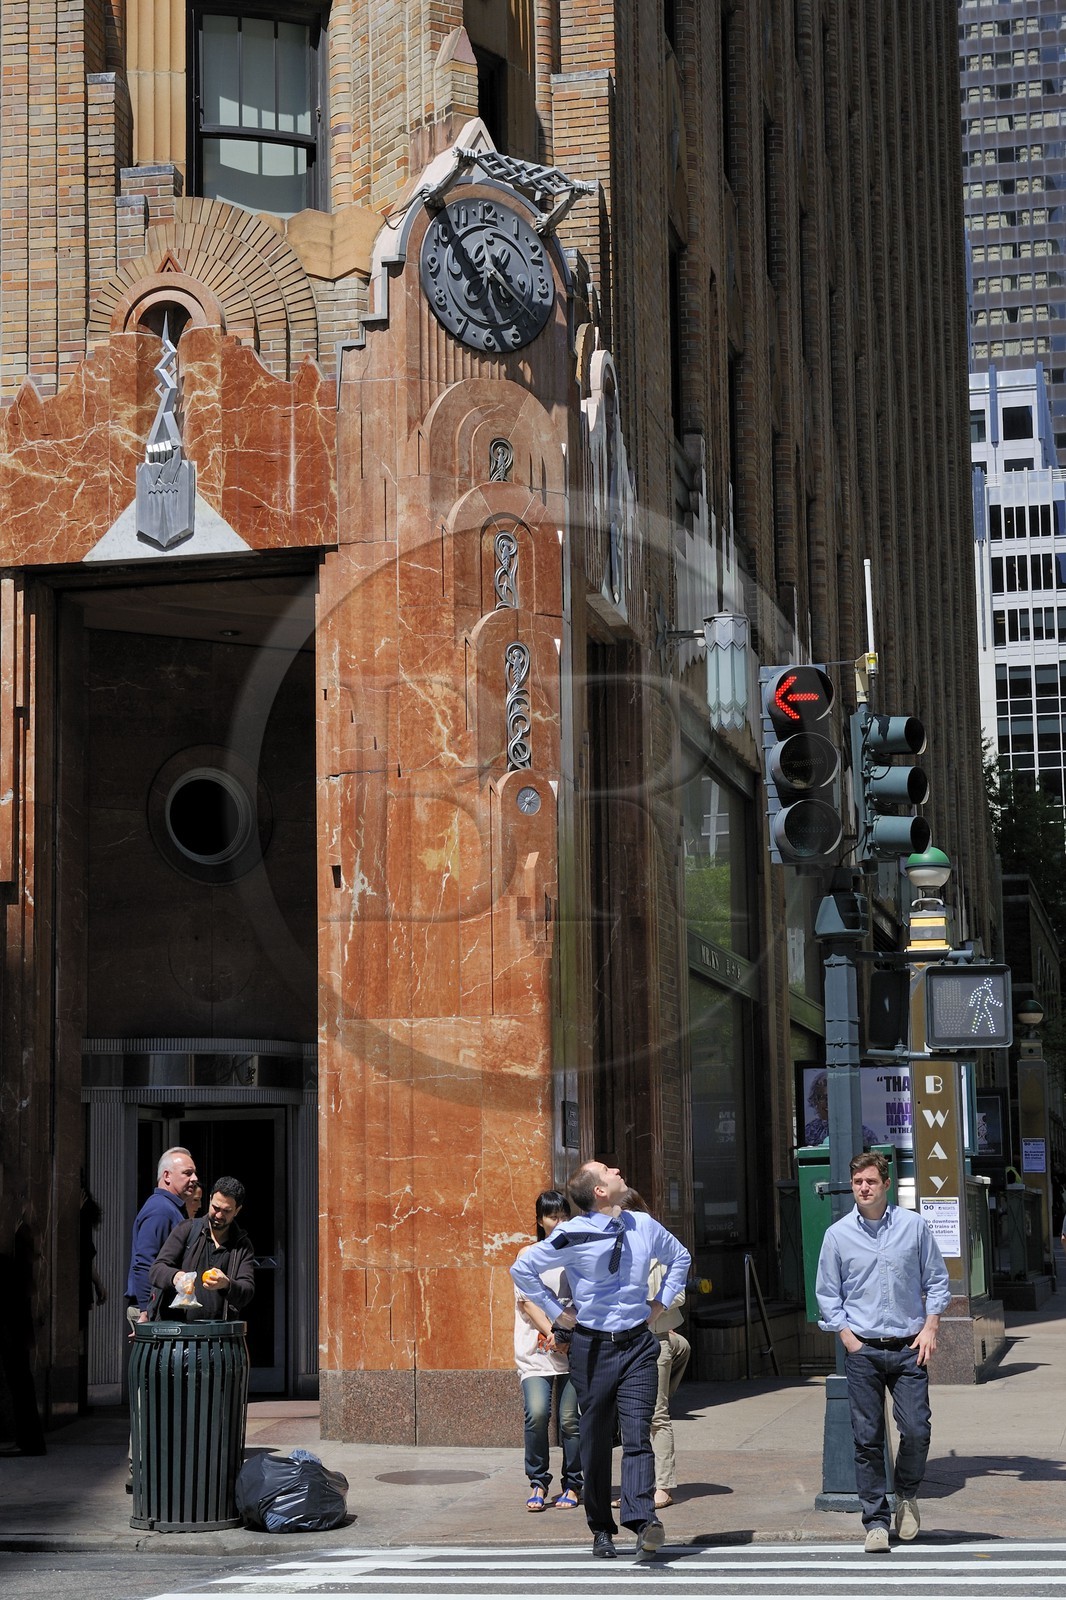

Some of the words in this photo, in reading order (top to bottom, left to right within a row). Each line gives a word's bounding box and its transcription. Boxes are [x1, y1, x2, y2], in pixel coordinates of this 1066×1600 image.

[453, 204, 468, 227] 11
[478, 201, 498, 223] 12
[512, 217, 519, 239] 1
[427, 254, 440, 274] 9
[529, 242, 544, 264] 2
[537, 275, 549, 298] 3
[434, 287, 447, 309] 8
[456, 317, 469, 336] 7
[482, 328, 496, 348] 6
[922, 1042, 949, 1194] BWAY
